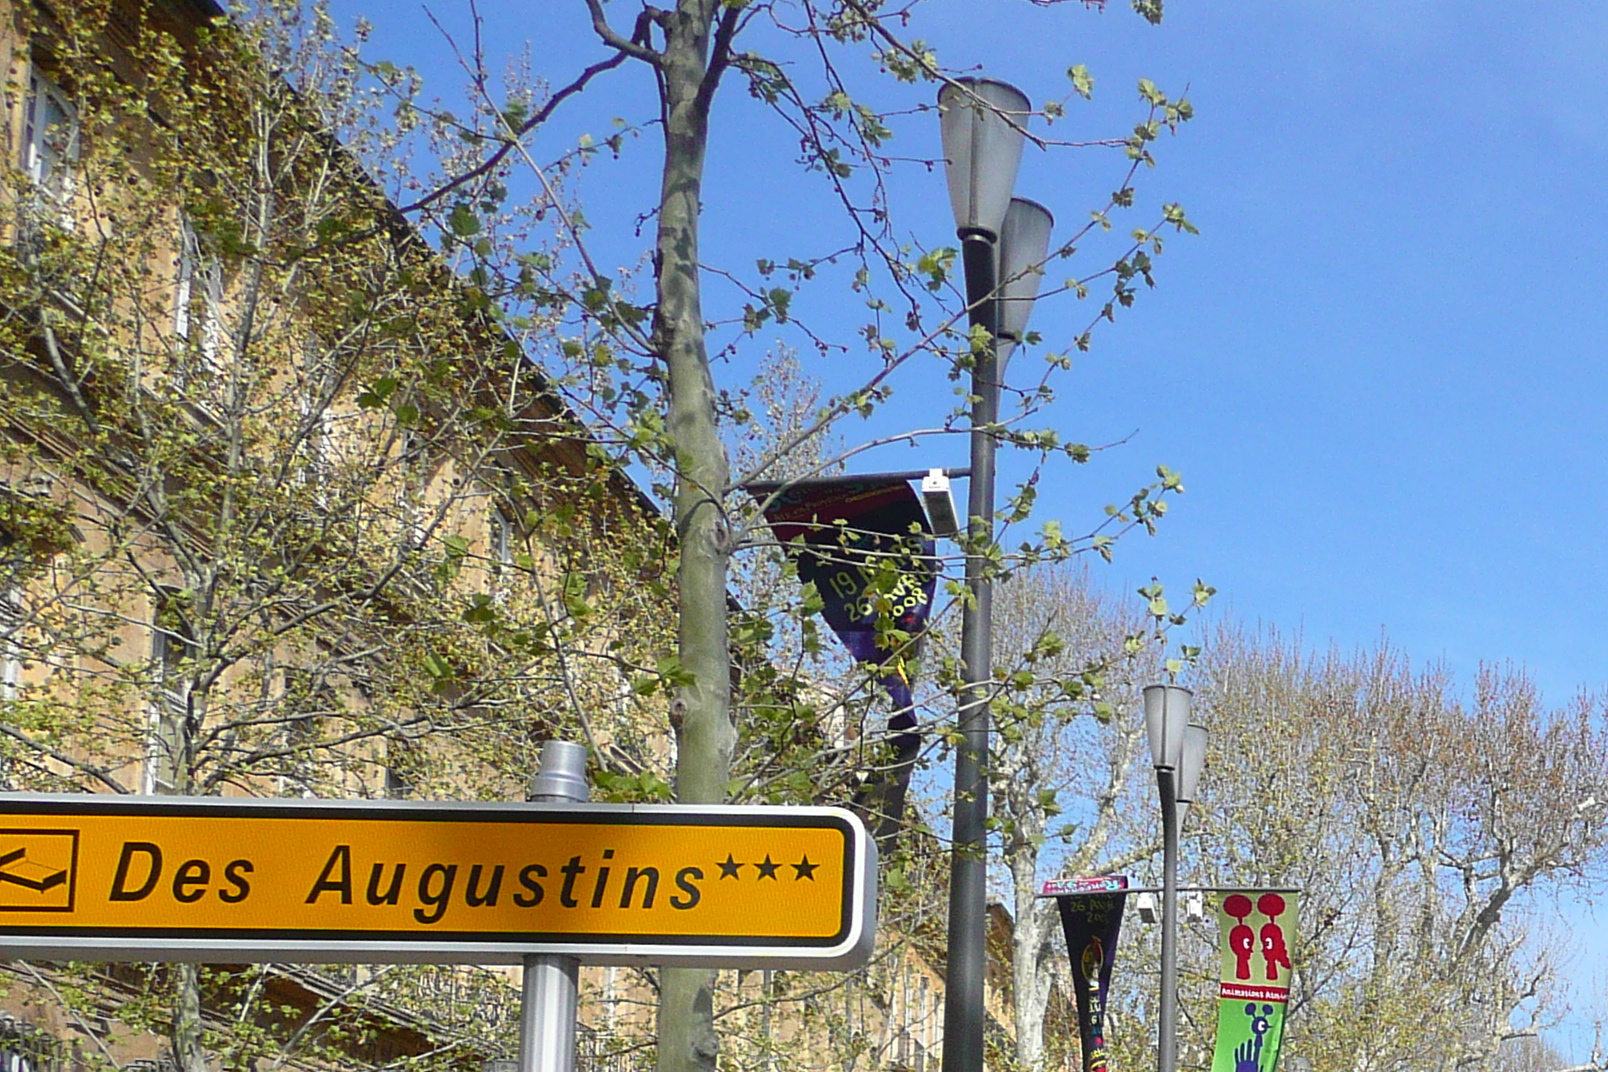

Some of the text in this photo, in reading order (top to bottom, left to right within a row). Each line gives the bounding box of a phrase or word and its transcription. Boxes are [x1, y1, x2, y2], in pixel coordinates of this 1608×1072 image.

[829, 571, 858, 600] 19
[844, 596, 874, 624] 26
[109, 842, 705, 925] Des Augustins
